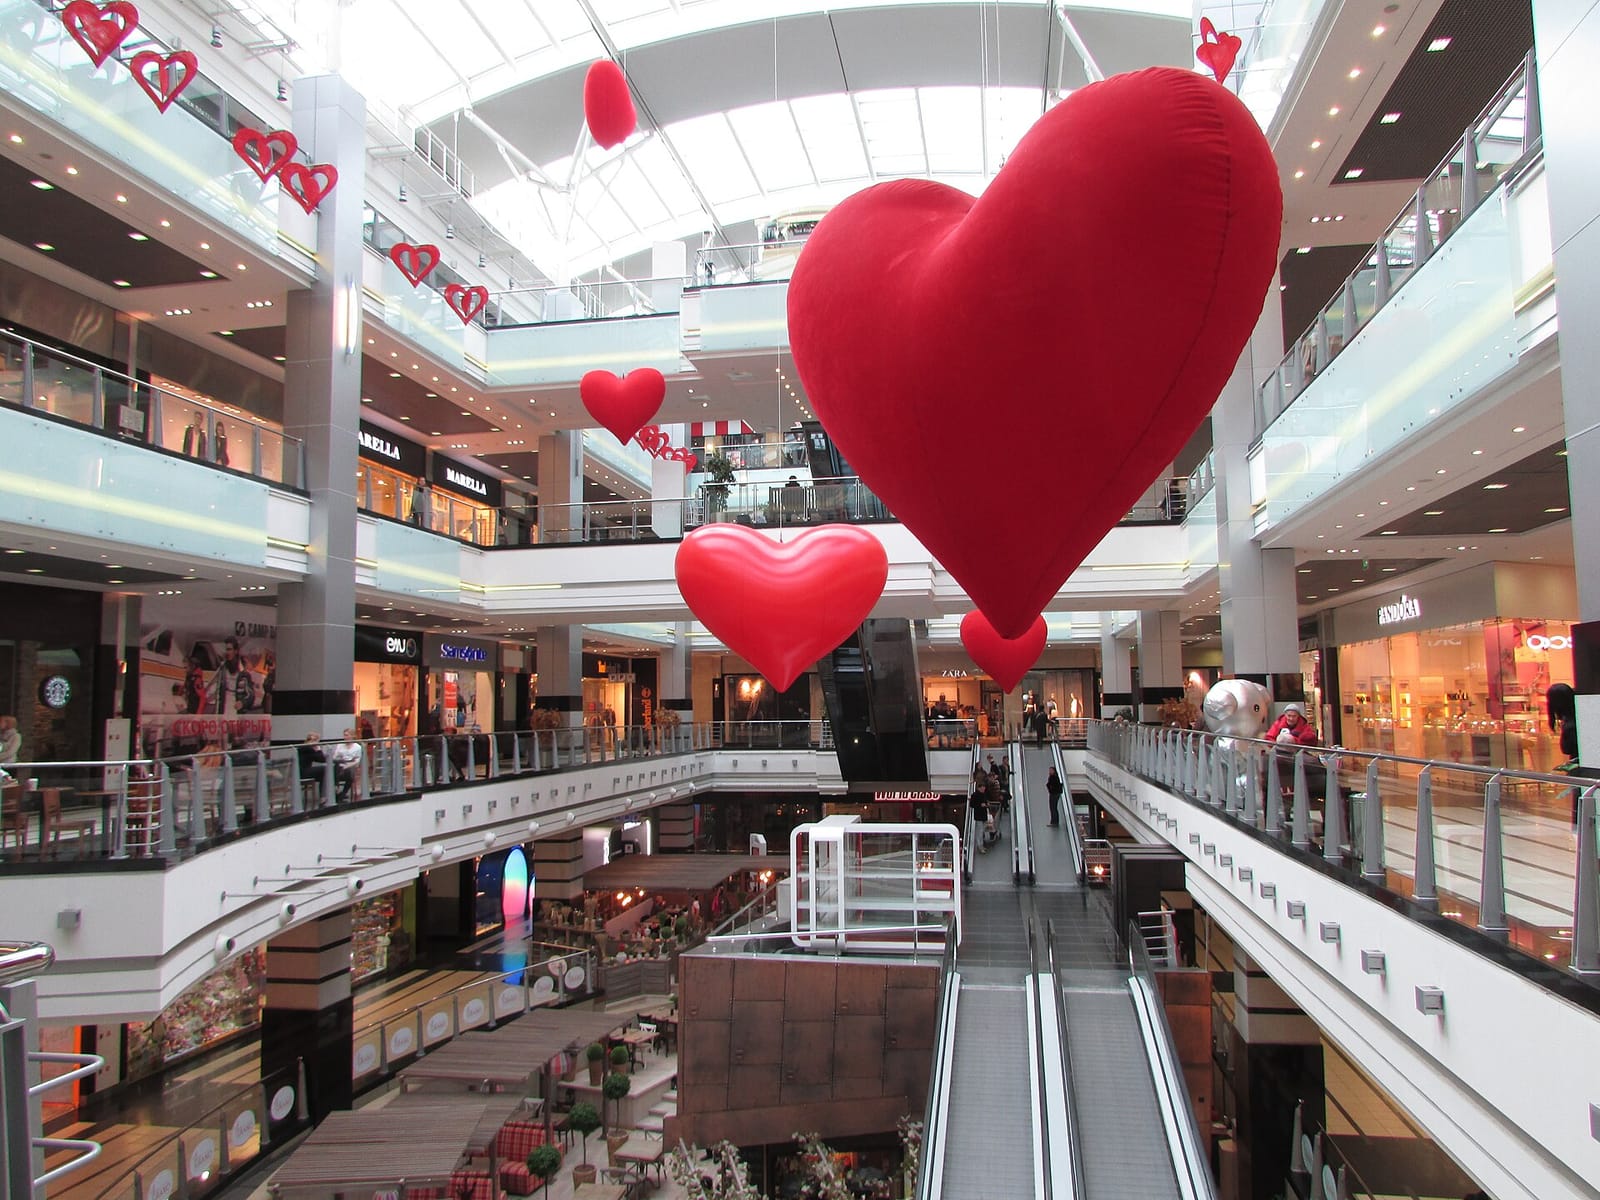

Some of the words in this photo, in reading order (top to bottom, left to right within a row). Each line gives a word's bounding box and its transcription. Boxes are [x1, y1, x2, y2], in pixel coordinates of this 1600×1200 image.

[358, 430, 401, 460] ARELLA
[446, 467, 487, 496] MARELLA
[1377, 594, 1421, 625] PANDORA
[942, 669, 968, 678] ZARA
[172, 719, 217, 736] СКОРО
